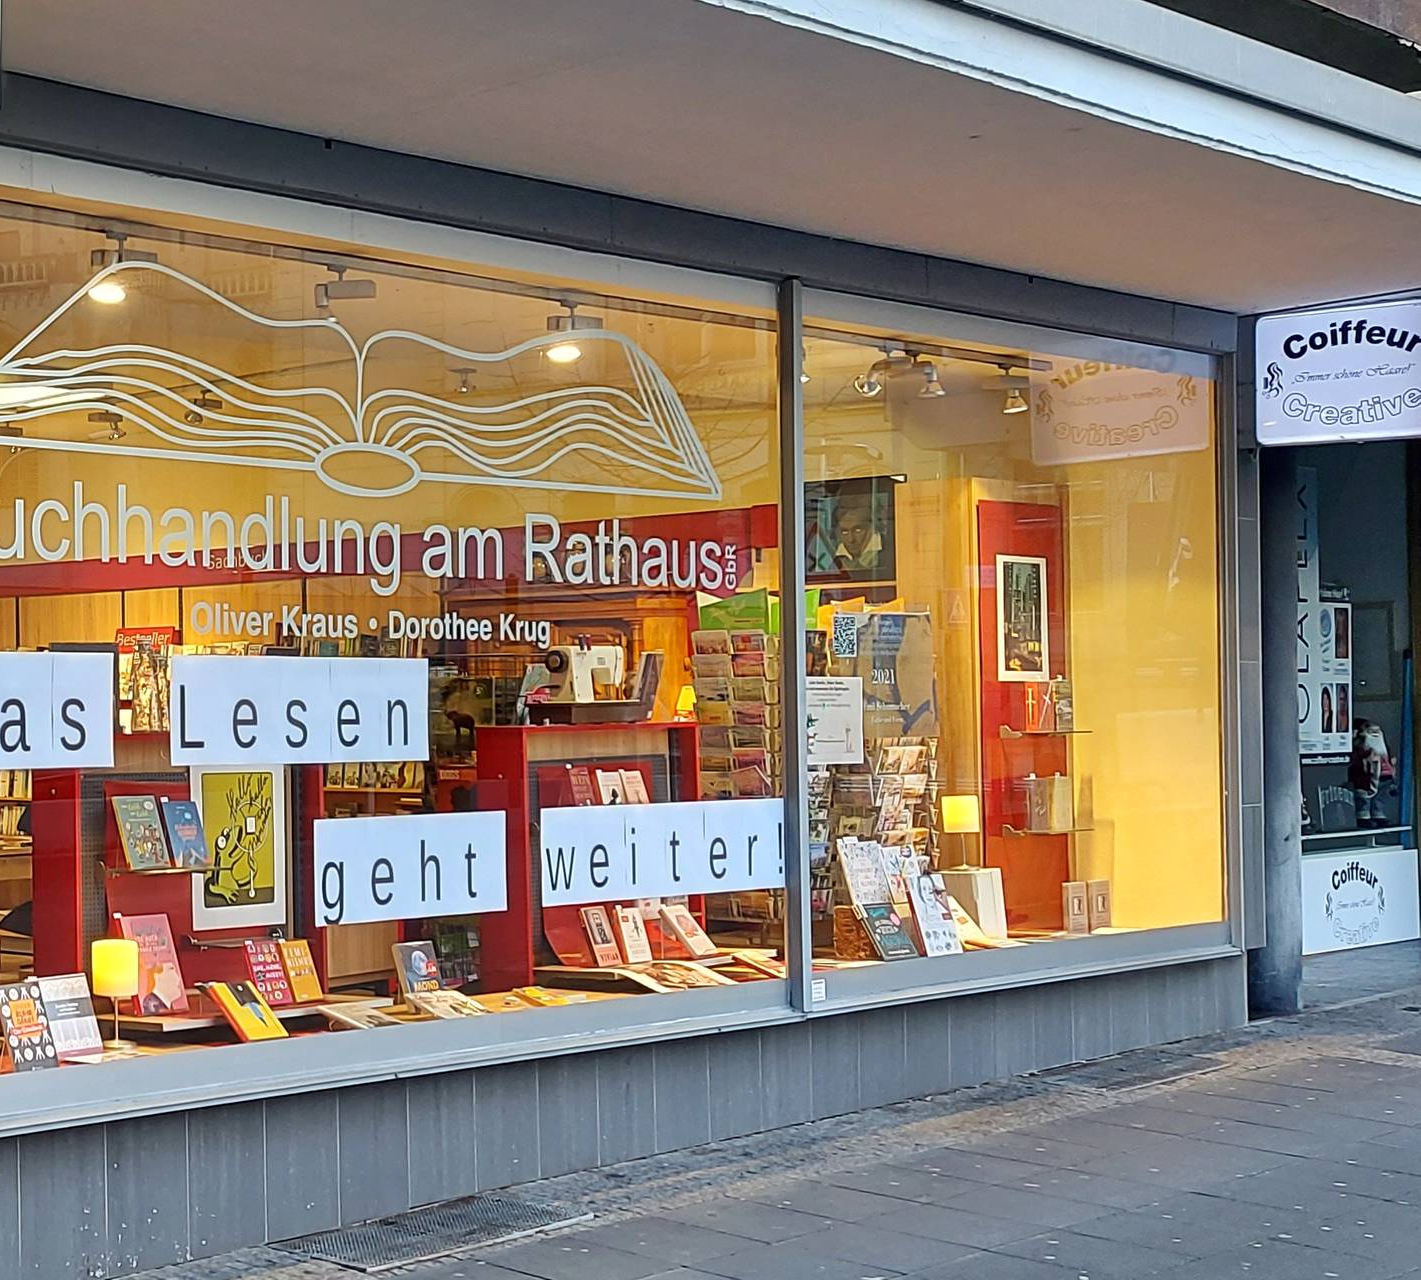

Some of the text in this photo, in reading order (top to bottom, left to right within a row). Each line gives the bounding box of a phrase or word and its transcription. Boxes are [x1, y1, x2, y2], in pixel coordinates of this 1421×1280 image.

[1283, 319, 1421, 359] Coiffeur
[1283, 388, 1421, 425] Creative
[421, 524, 505, 581] am
[524, 512, 723, 592] Rathaus
[724, 542, 739, 590] GbR
[191, 600, 552, 647] Oliver Kraus Dorothee Krug
[872, 668, 895, 685] 2021
[180, 681, 410, 752] Lesen
[321, 821, 784, 926] geht weiter!
[1331, 861, 1378, 890] Coiffeur
